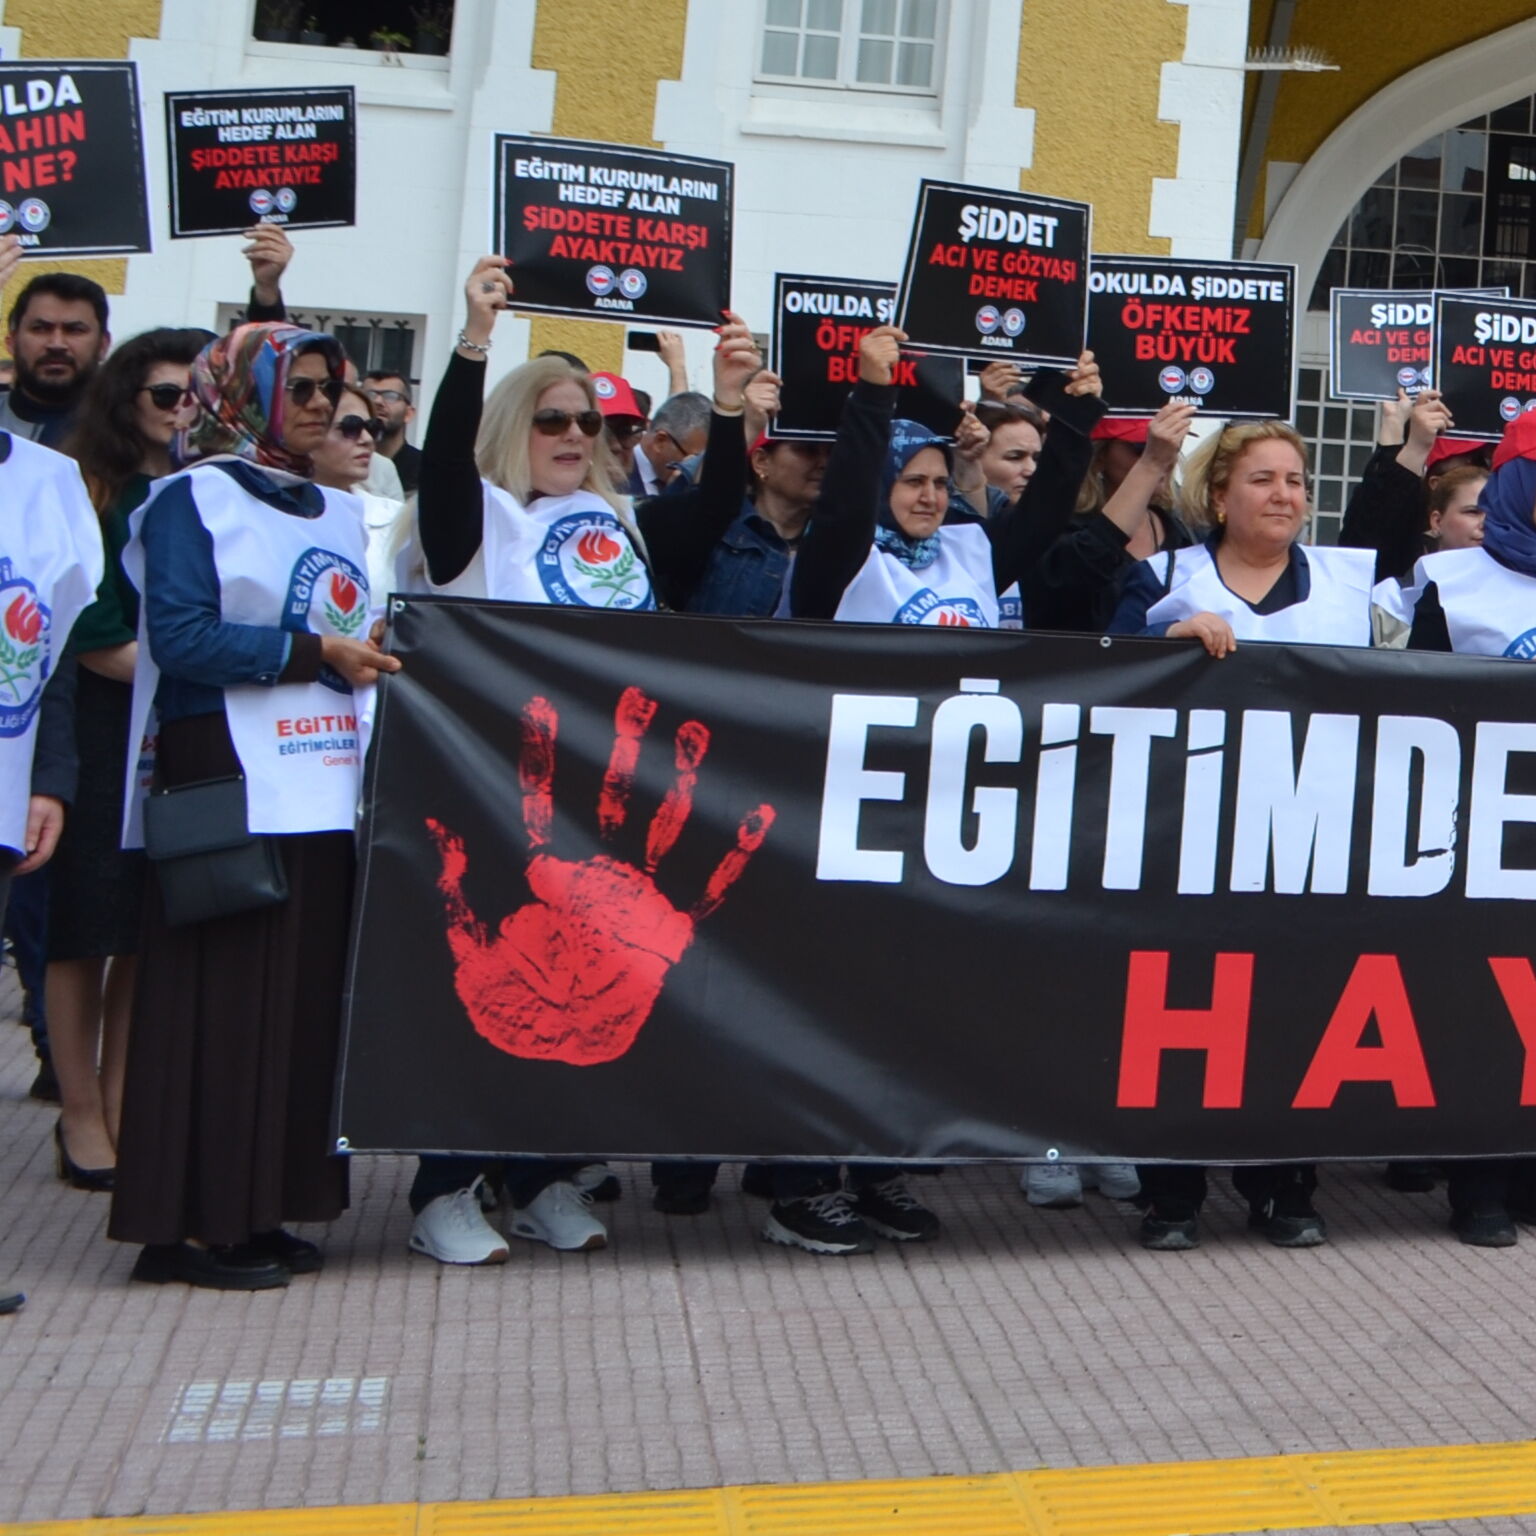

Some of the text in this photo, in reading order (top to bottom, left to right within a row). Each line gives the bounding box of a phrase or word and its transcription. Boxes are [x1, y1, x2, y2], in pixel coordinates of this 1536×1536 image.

[0, 74, 83, 116] LDA
[181, 106, 345, 127] EĞİTİM KURUMLARINI
[218, 124, 317, 143] HEDEF ALAN
[3, 149, 78, 192] NE?
[190, 143, 339, 171] ŞİDDETE KARŞI
[214, 165, 322, 189] AYAKTAYIZ
[514, 156, 718, 201] EĞİTİM KURUMLARINI
[558, 183, 681, 216] HEDEF ALAN
[522, 205, 709, 252] ŞİDDETE KARŞI
[958, 204, 1059, 248] ŞİDDET
[549, 235, 685, 272] AYAKTAYIZ
[929, 243, 1078, 285] ACI VE GÖZYAŞI
[968, 273, 1039, 302] DEMEK
[1088, 271, 1284, 302] OKULDA ŞİDDETE
[594, 297, 634, 311] ADANA
[785, 291, 873, 319] OKULDA
[1121, 298, 1251, 334] ÖFKEMİZ
[1135, 330, 1237, 364] BÜYÜK
[1350, 329, 1409, 345] ACI VE
[1452, 345, 1485, 365] ACI
[1490, 349, 1514, 368] VE
[278, 738, 354, 755] EĞİTİMCİLER
